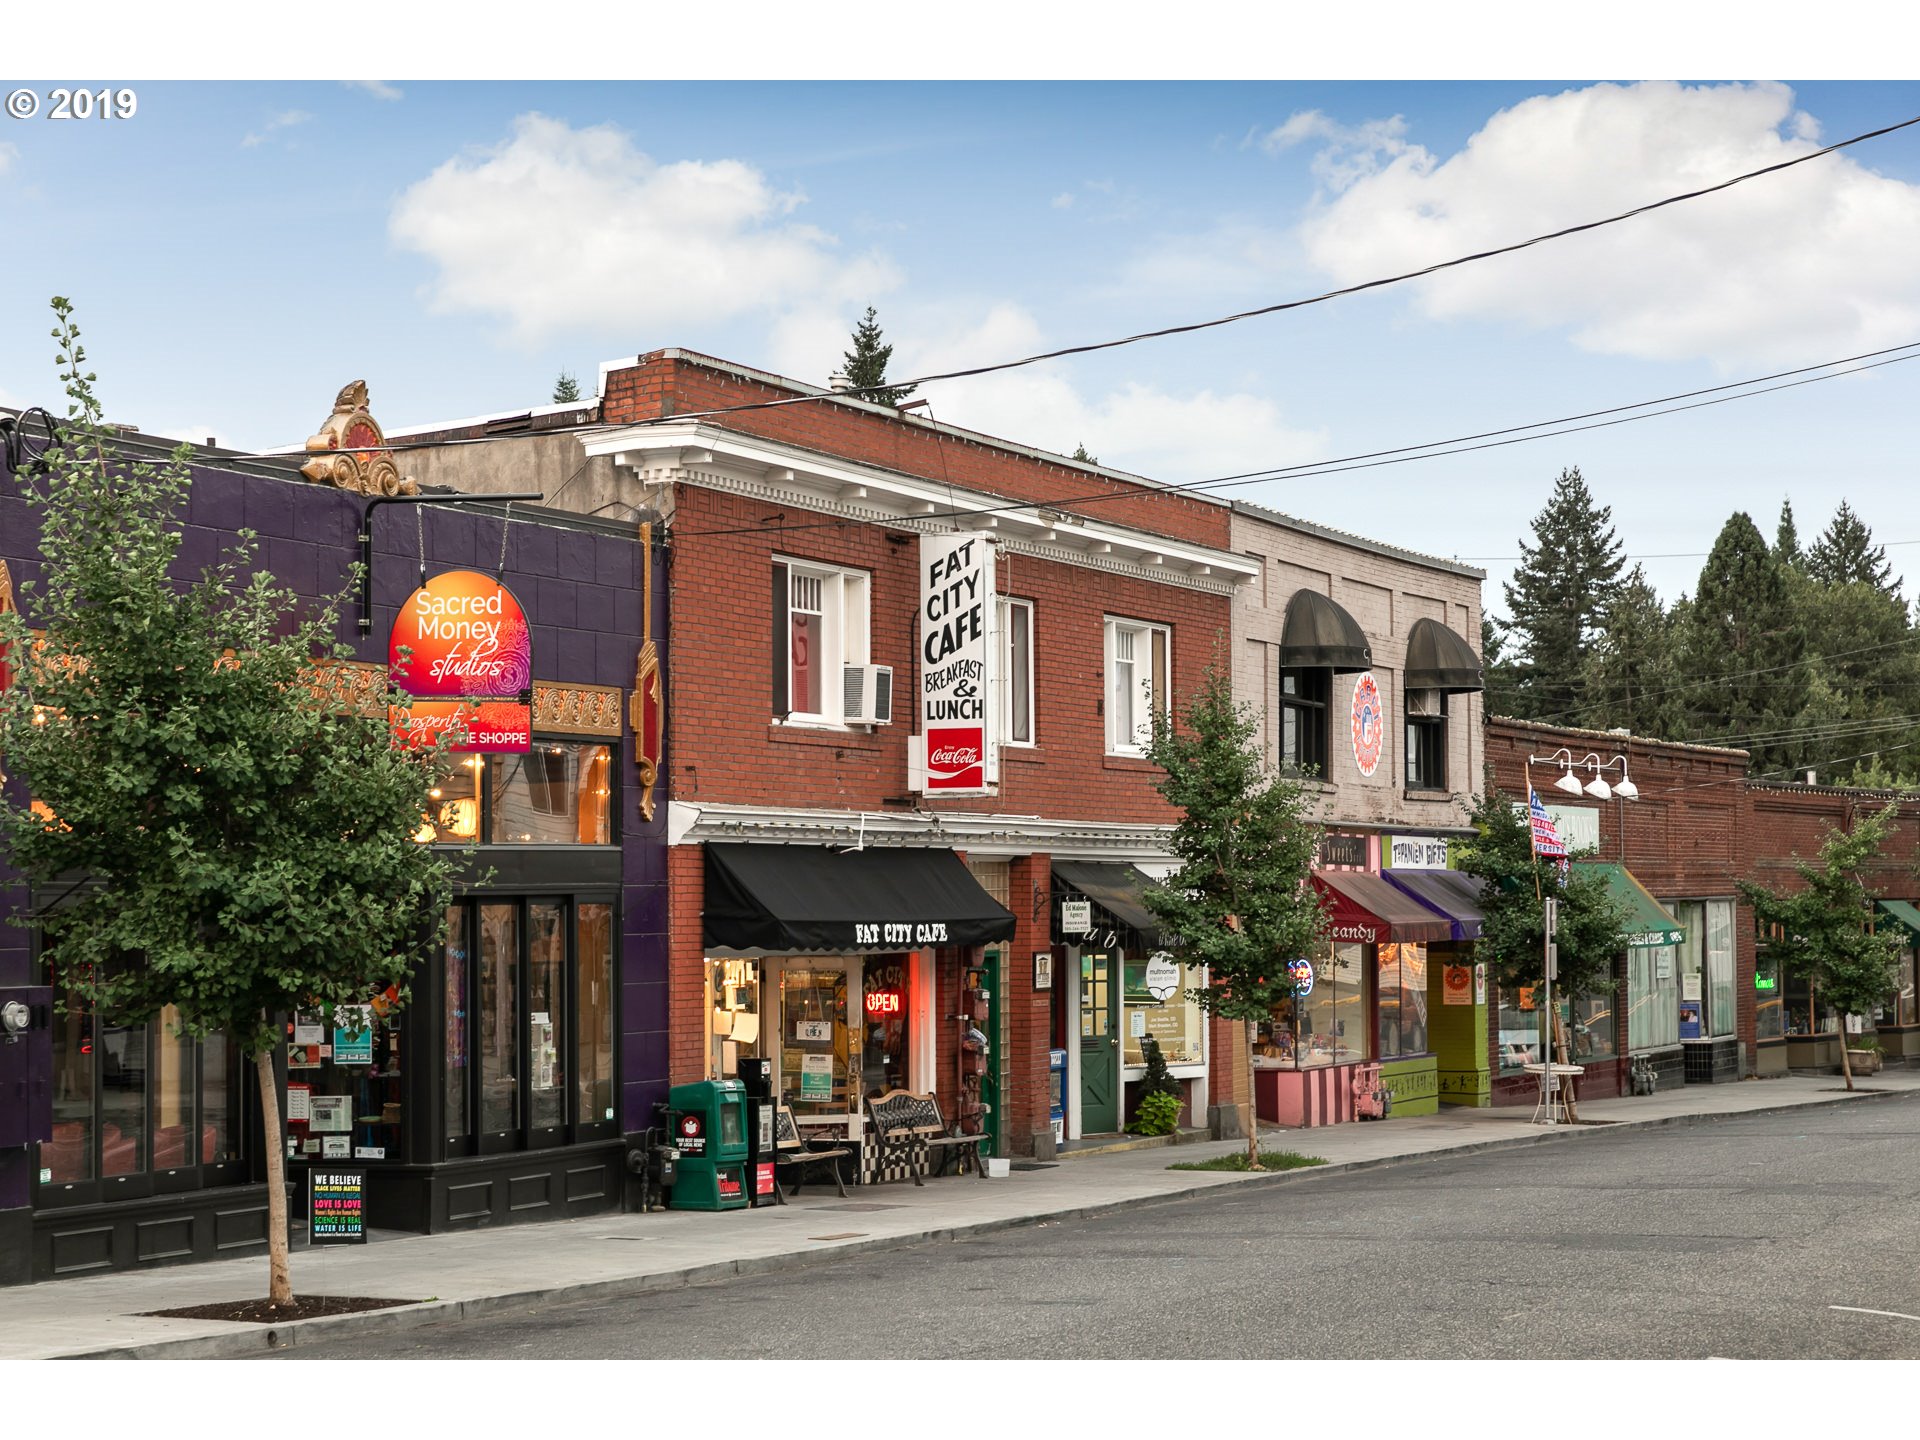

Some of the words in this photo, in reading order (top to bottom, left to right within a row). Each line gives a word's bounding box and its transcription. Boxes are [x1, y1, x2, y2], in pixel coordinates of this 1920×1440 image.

[929, 538, 976, 589] FAT
[415, 590, 502, 615] Sacred
[926, 568, 980, 622] CITY
[418, 616, 501, 646] Money
[924, 603, 982, 665] CAFE
[429, 638, 505, 684] studios
[925, 659, 984, 694] BREAKFAST
[953, 679, 977, 698] &
[926, 699, 983, 720] LUNCH
[479, 733, 527, 744] SHOPPE
[1426, 842, 1447, 865] GIFTS
[855, 924, 879, 944] FAT
[884, 923, 913, 943] CITY
[916, 923, 948, 943] CAFE
[1332, 923, 1376, 943] candy
[866, 993, 899, 1012] OPEN
[315, 1174, 328, 1185] WE
[330, 1175, 362, 1185] BELIEVE
[315, 1199, 333, 1208] LOVE
[335, 1199, 342, 1208] IS
[344, 1199, 362, 1208] LOVE
[315, 1216, 339, 1224] SCIENCE
[347, 1216, 361, 1224] REAL
[315, 1224, 337, 1232] WATER
